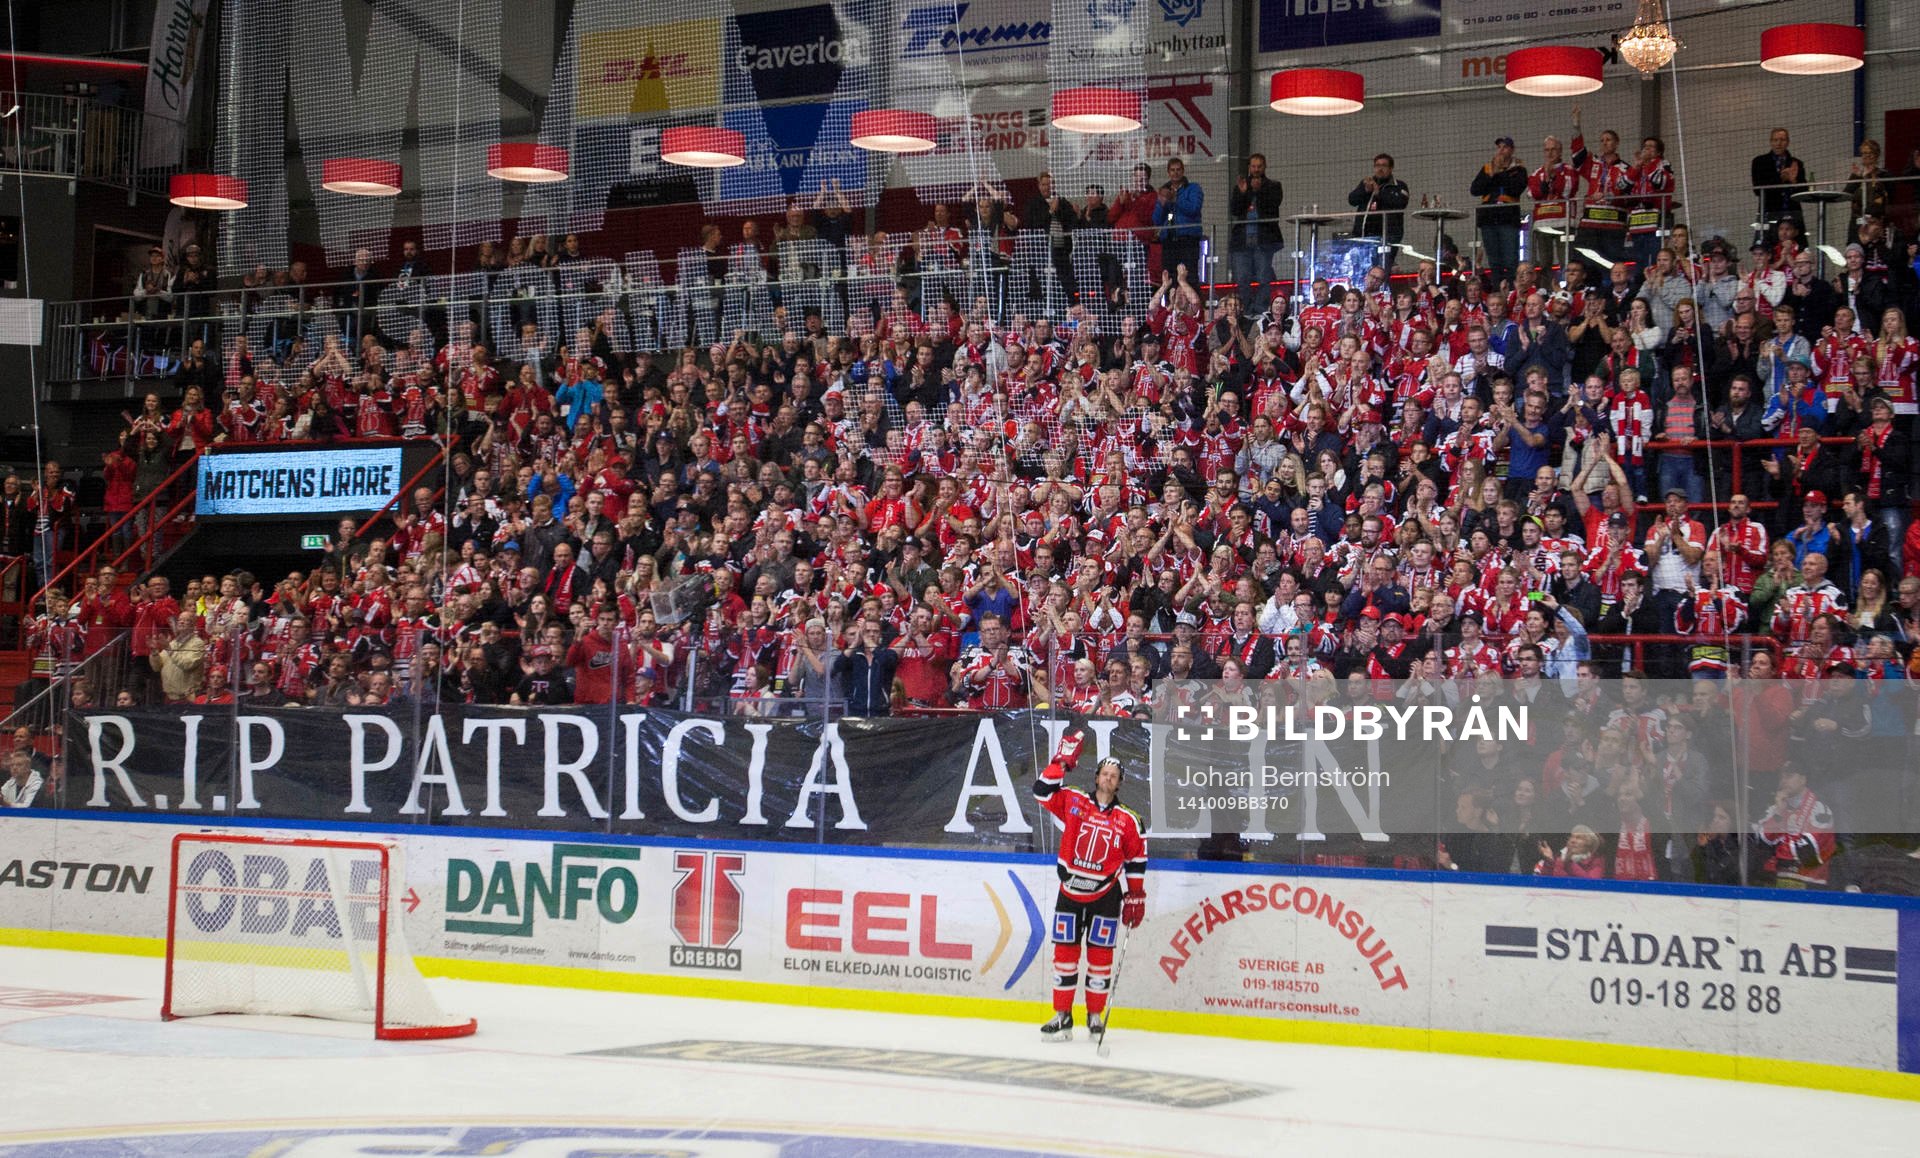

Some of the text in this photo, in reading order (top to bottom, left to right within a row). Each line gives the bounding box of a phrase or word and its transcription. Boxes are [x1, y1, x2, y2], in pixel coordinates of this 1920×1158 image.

[735, 36, 869, 72] Caverion
[204, 468, 315, 500] MATCHENS
[85, 714, 285, 810] R.I.P
[343, 714, 868, 831] PATRICIA
[0, 859, 154, 894] ASTON
[445, 844, 641, 937] DANFO
[786, 887, 973, 961] EEL
[1158, 882, 1409, 993] AFFÄRSCONSULT
[672, 948, 740, 970] ÖREBRO
[784, 957, 972, 982] ELON ELKEDJAN LOGISTIC
[1239, 957, 1325, 975] SVERIGE AB
[1779, 943, 1838, 979] AB
[1242, 977, 1320, 994] 019-184570
[1590, 976, 1782, 1015] 019-18 28 88
[1203, 996, 1361, 1017] www.affarsconsult.se
